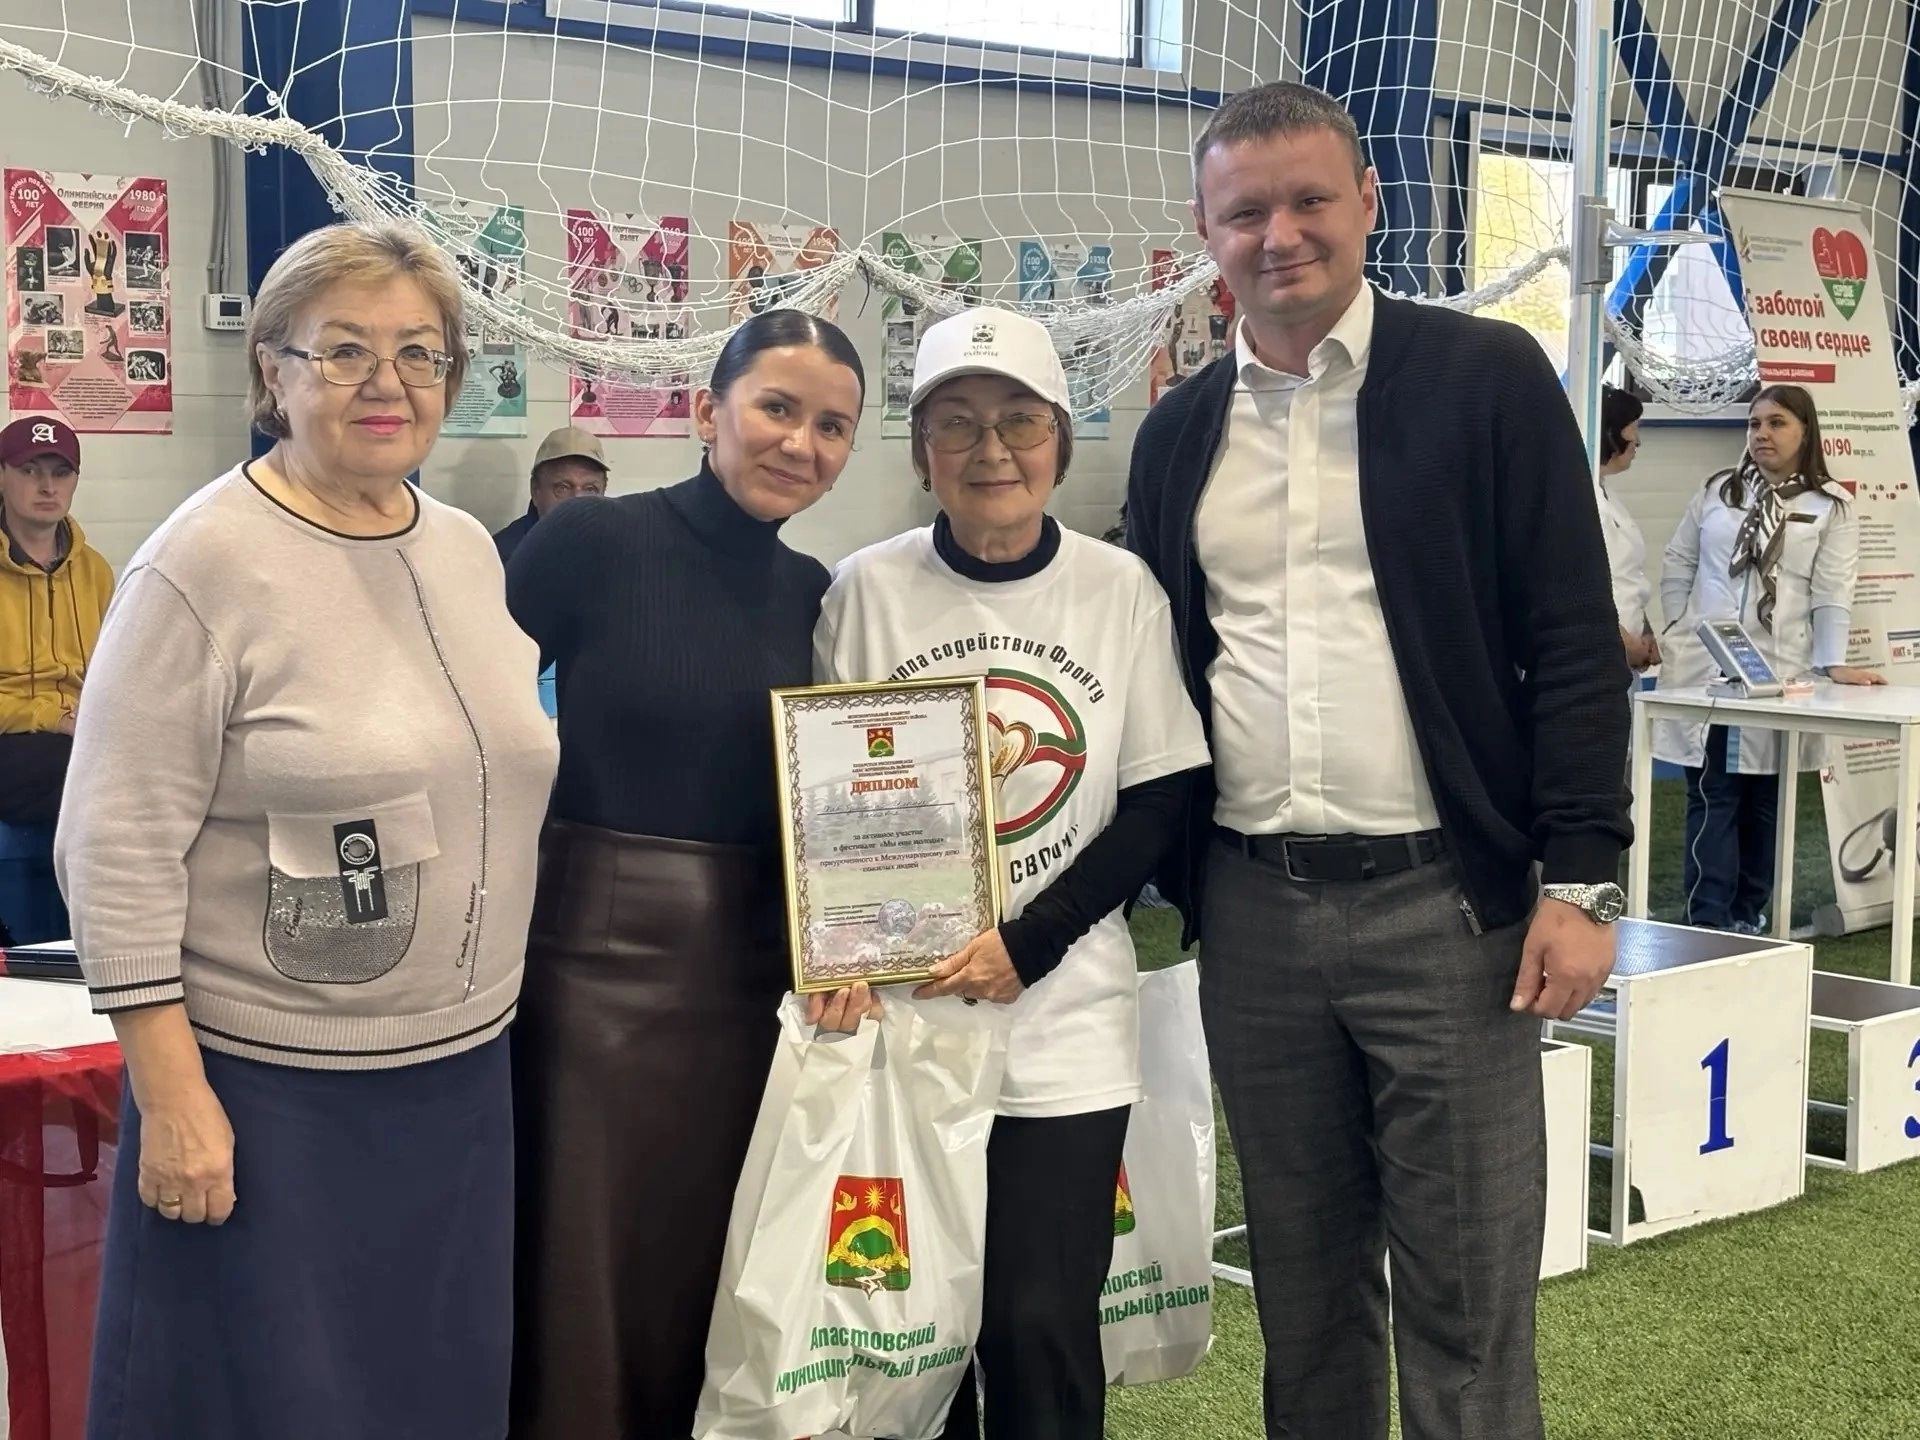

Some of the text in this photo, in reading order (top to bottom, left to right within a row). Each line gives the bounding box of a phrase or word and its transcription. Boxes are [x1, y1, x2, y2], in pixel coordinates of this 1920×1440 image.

[17, 189, 40, 201] 100
[577, 227, 594, 236] 100
[891, 247, 904, 257] 100
[1027, 256, 1040, 266] 100
[1755, 289, 1826, 318] заботой
[1760, 328, 1813, 352] своем
[1815, 331, 1871, 358] сердце
[1821, 438, 1852, 457] 0/90
[931, 632, 1046, 662] содействия
[1049, 644, 1106, 704] Фронту
[850, 778, 920, 795] ДИПЛОМ
[1699, 1037, 1735, 1156] 1
[1154, 1285, 1210, 1315] район
[810, 1322, 936, 1351] Апастовский
[916, 1345, 968, 1377] район
